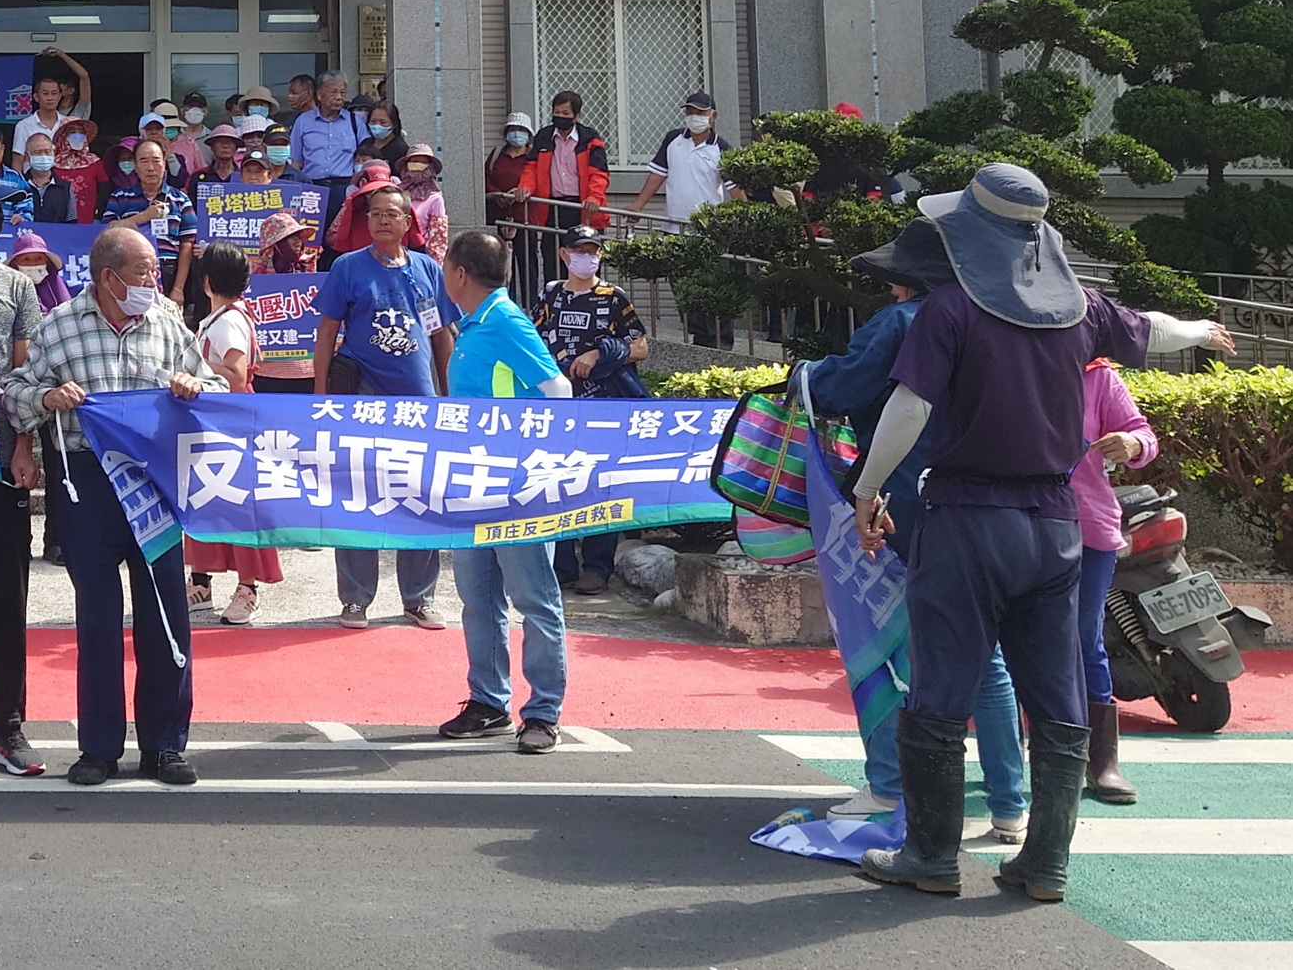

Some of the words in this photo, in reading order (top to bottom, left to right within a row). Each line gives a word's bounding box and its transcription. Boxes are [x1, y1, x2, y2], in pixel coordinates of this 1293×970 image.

[206, 189, 284, 216] 骨塔進逼
[485, 503, 625, 541] 頂庄反二塔自救會
